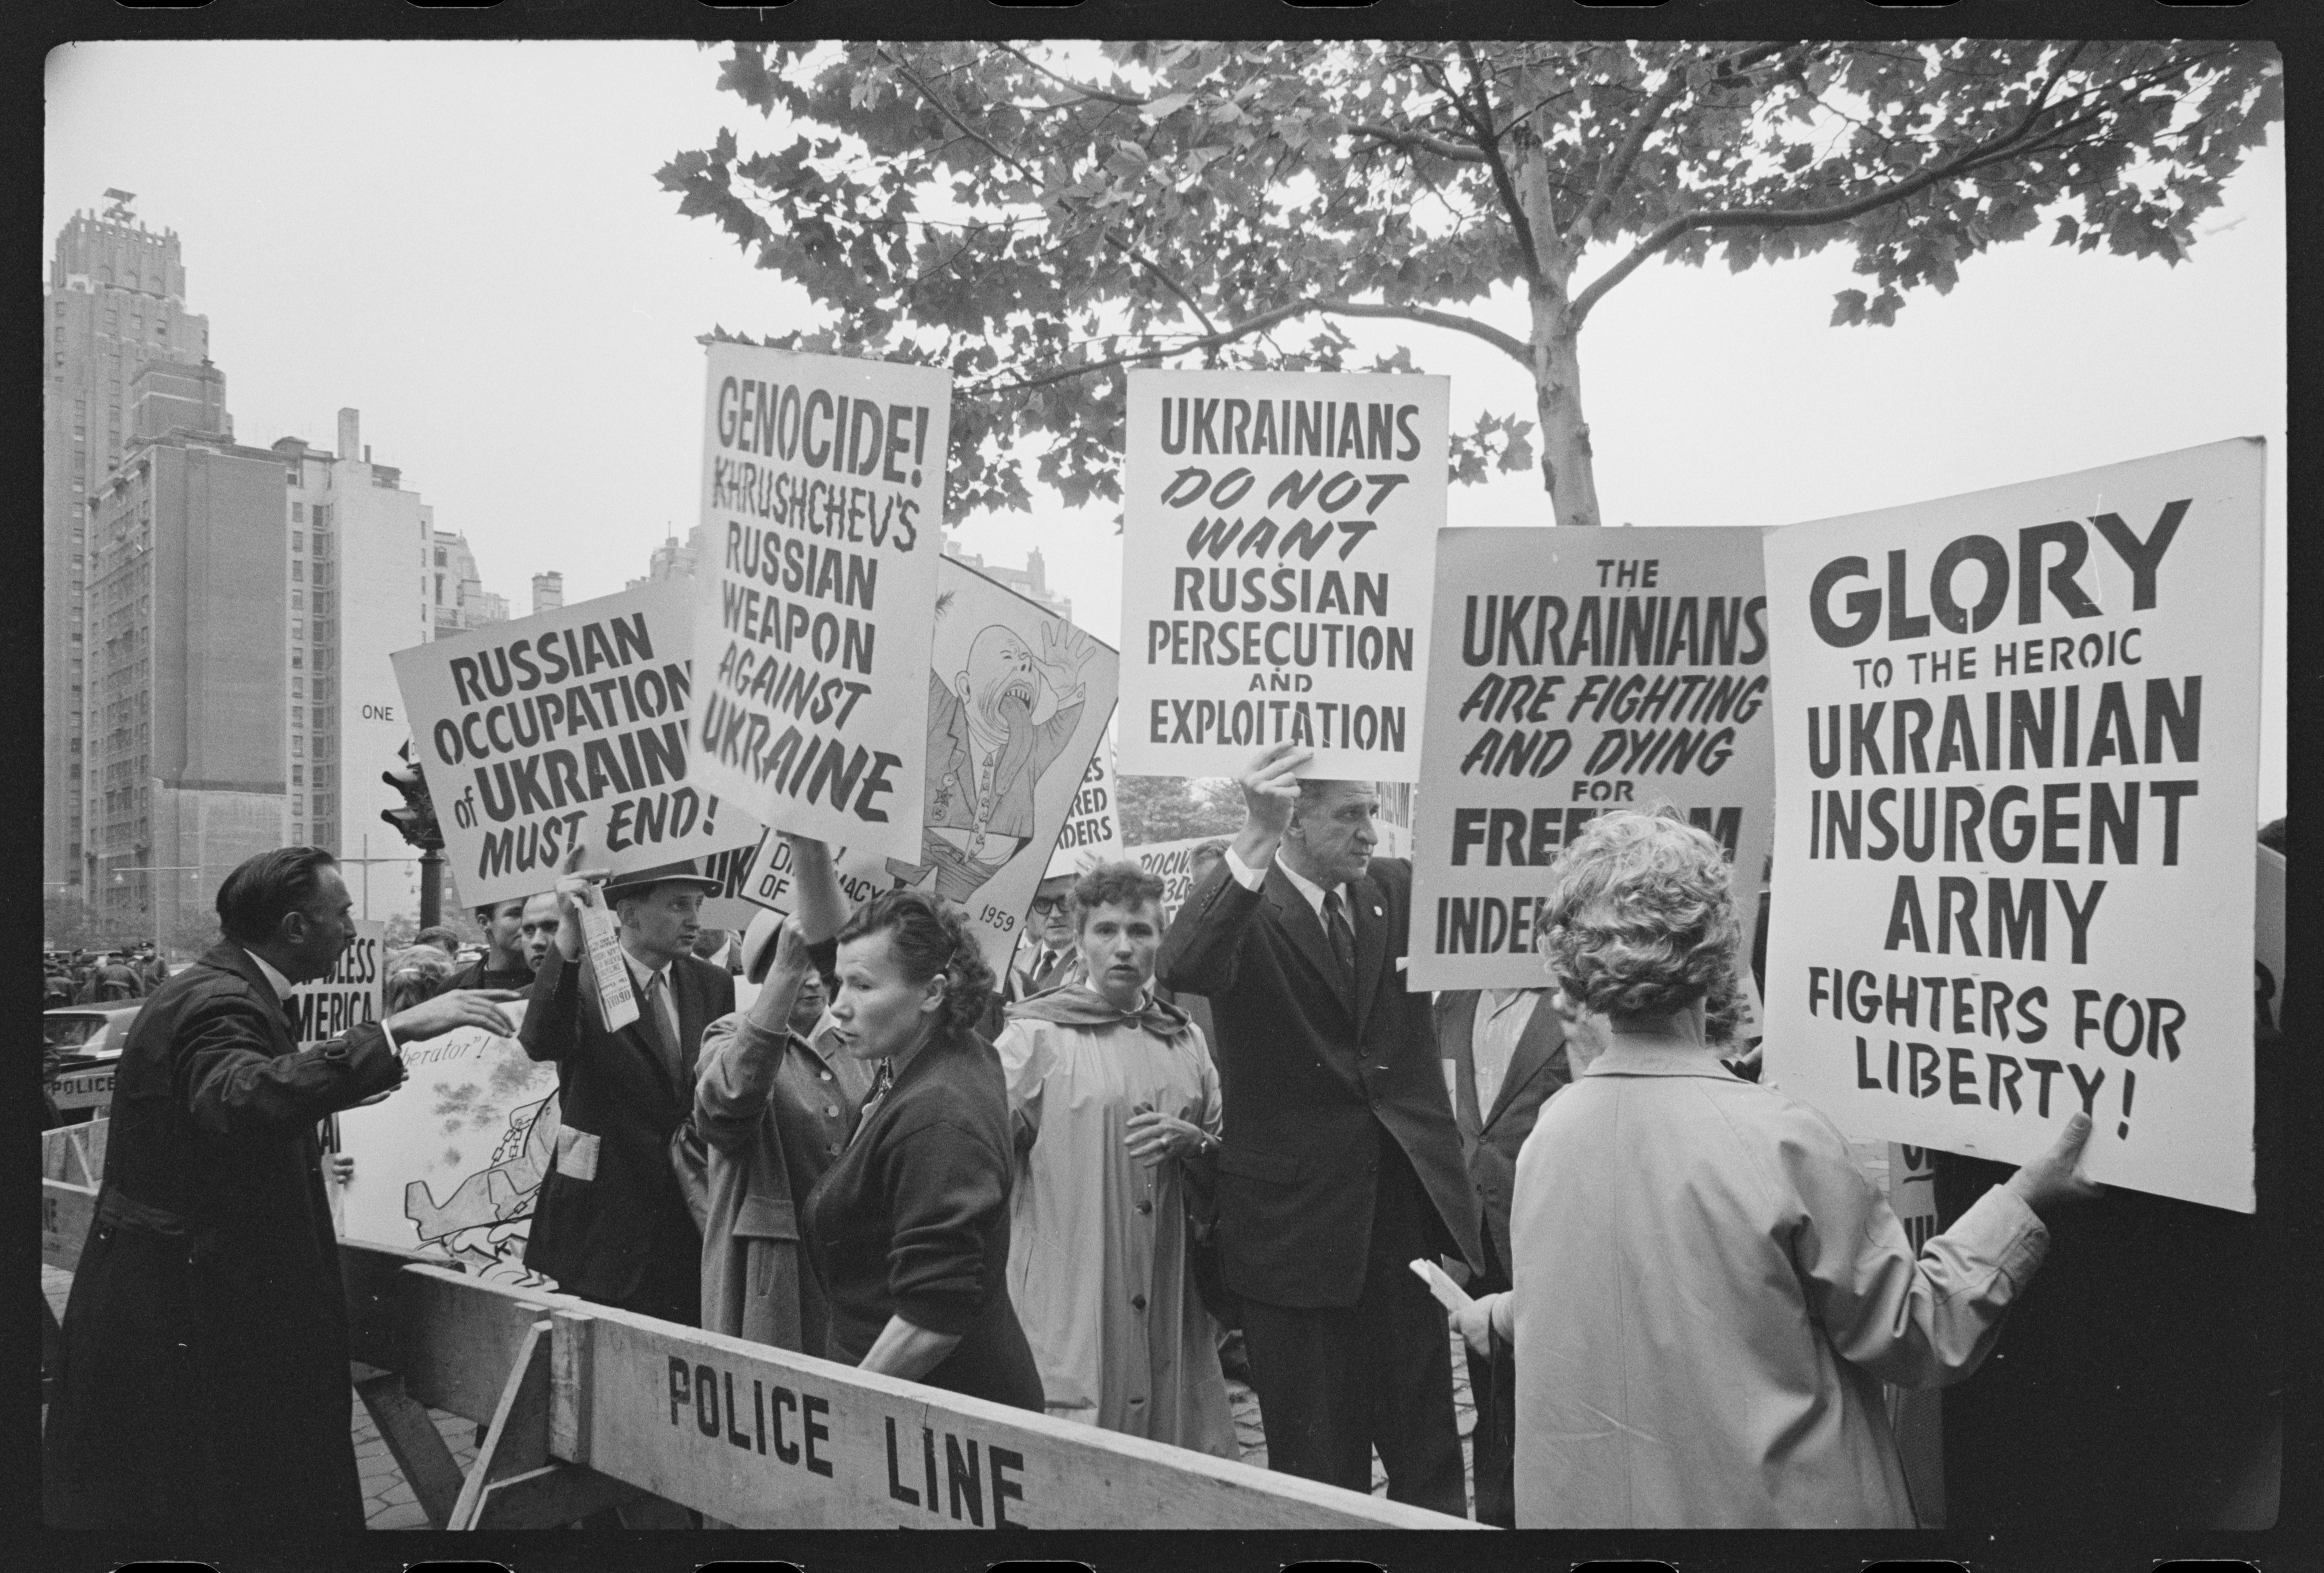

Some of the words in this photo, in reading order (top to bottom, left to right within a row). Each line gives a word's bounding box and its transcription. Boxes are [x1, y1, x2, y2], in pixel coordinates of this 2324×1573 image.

[718, 376, 930, 487] GENOCIDE!
[1161, 397, 1421, 462] UKRAINIANS
[712, 455, 920, 552] KHRUSHCHEV'S
[1160, 466, 1256, 510] DO
[1267, 468, 1410, 516] NOT
[725, 520, 878, 611] RUSSIAN
[1186, 516, 1378, 562] WANT
[1174, 567, 1389, 617] RUSSIAN
[1596, 559, 1659, 588] THE
[1809, 498, 2193, 648] GLORY
[449, 612, 654, 706] RUSSIAN
[723, 579, 876, 675] WEAPON
[1147, 620, 1414, 671] PERSECUTION
[1462, 595, 1768, 667] UKRAINIANS
[1853, 657, 1893, 690] TO
[1908, 647, 1977, 685] THE
[1995, 628, 2142, 676] HEROIC
[362, 705, 394, 721] ONE
[433, 659, 692, 765] OCCUPATION
[718, 640, 872, 731] AGAINST
[1249, 673, 1313, 693] AND
[1459, 672, 1565, 724] ARE
[1567, 673, 1769, 725] FIGHTING
[702, 690, 903, 823] UKRAINE
[1150, 698, 1406, 752] EXPLOITATION
[1459, 727, 1572, 778] AND
[1583, 726, 1735, 776] DYING
[1807, 675, 2202, 779] UKRAINIAN
[454, 786, 479, 829] of
[1571, 780, 1634, 802] FOR
[1810, 779, 2199, 866] INSURGENT
[479, 810, 588, 880] MUST
[606, 786, 719, 852] END!
[759, 874, 790, 900] OF
[979, 904, 1014, 932] 1959
[1884, 875, 2108, 964] ARMY
[283, 991, 372, 1042] MERICA
[1809, 967, 2049, 1044] FIGHTERS
[2072, 989, 2186, 1062] FOR
[51, 1077, 116, 1095] POLICE
[1856, 1035, 2136, 1141] LIBERTY!
[668, 1355, 833, 1479] POLICE
[885, 1415, 1028, 1530] LINE
